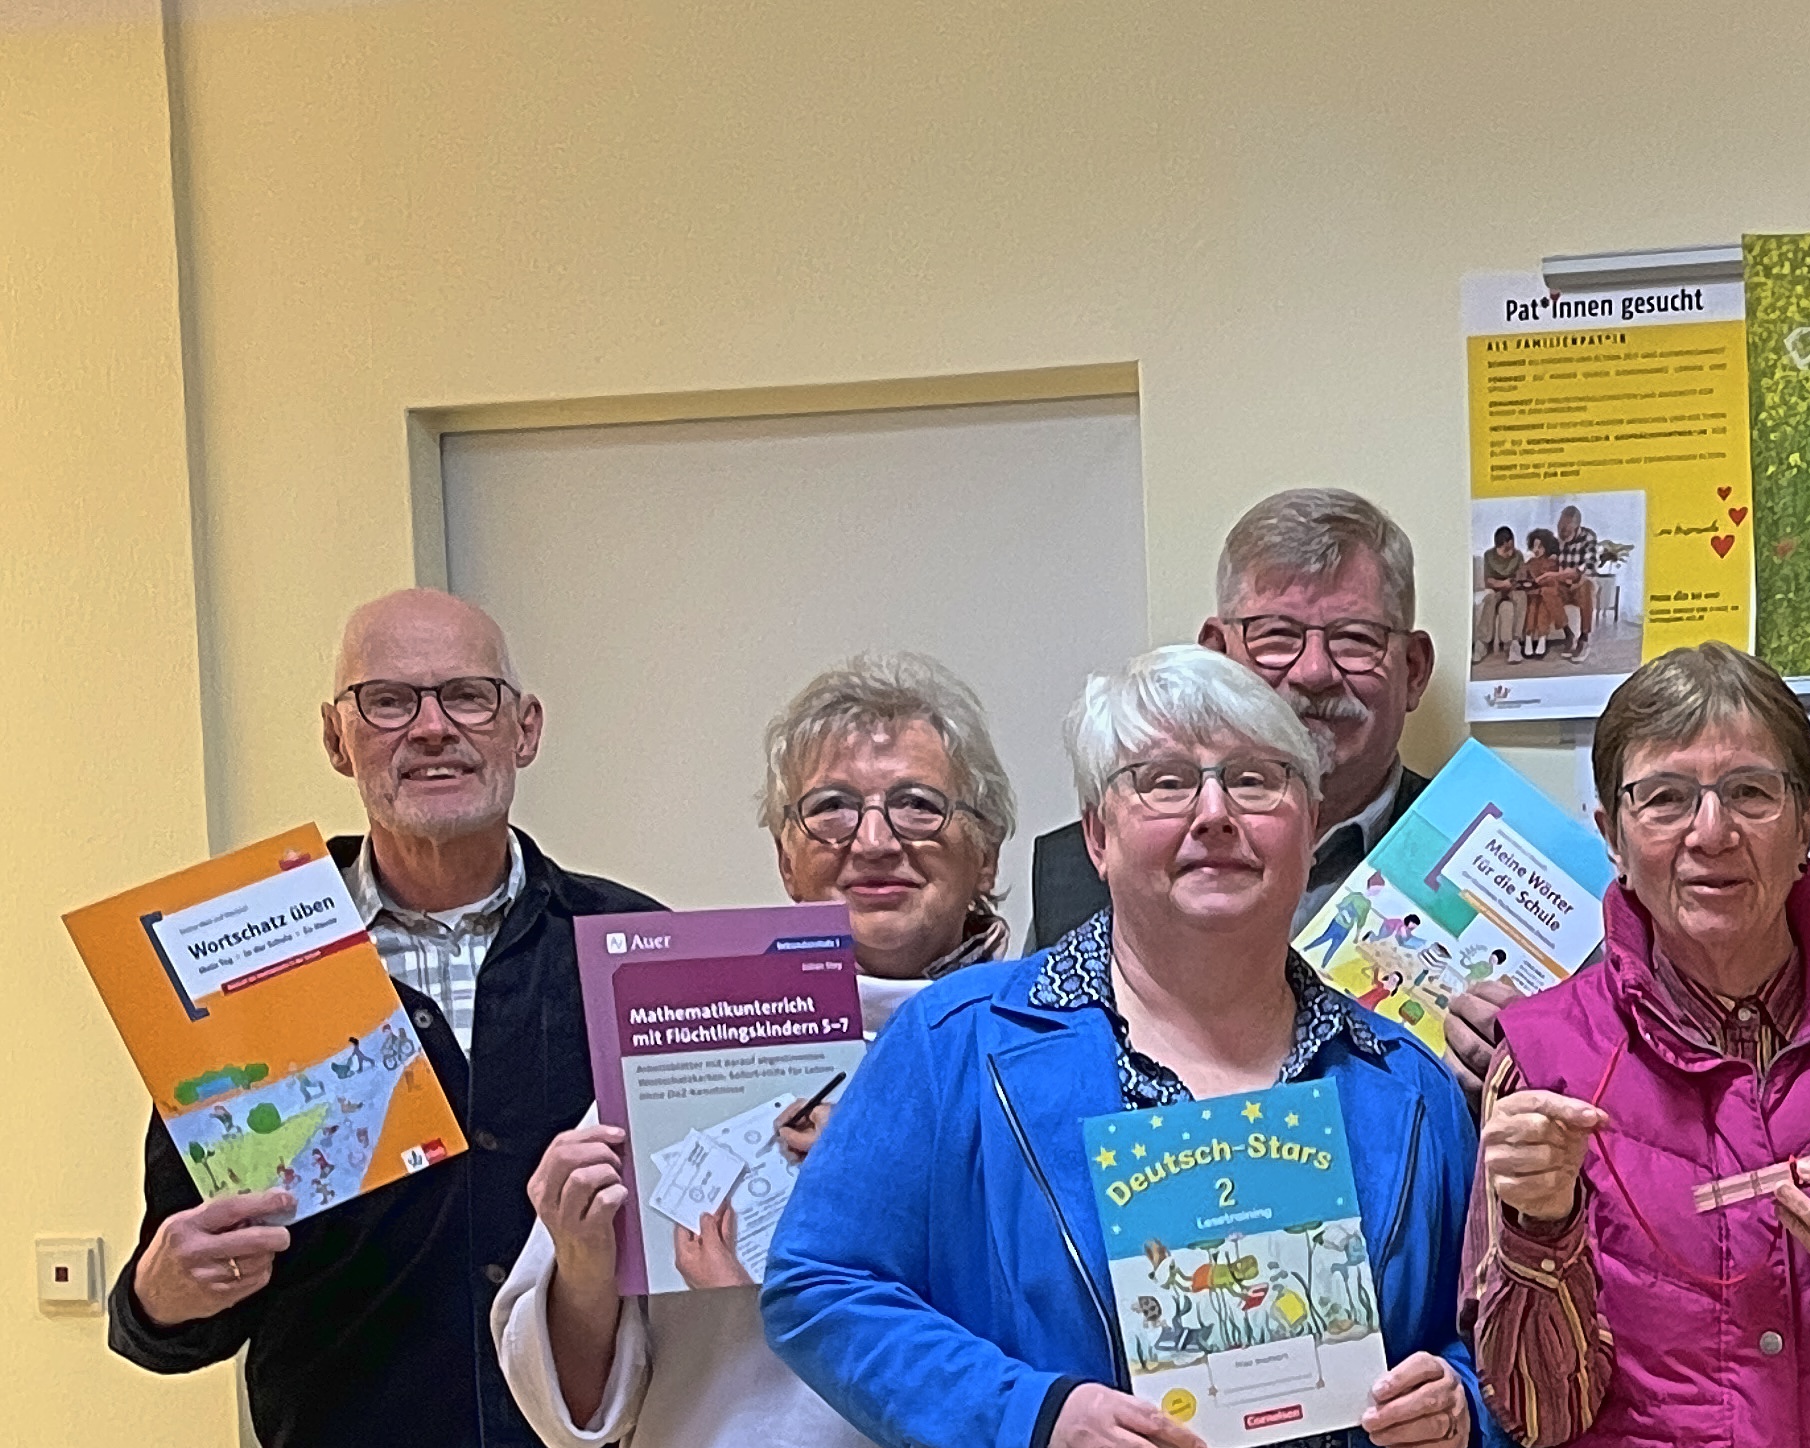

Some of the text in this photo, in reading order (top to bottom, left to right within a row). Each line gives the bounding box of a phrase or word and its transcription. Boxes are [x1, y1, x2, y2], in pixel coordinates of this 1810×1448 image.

[1621, 288, 1705, 320] gesucht
[1485, 838, 1527, 878] Meine
[1528, 870, 1574, 914] Wörter
[1472, 854, 1560, 931] für die Schule
[187, 913, 288, 960] Wortschatz
[290, 896, 336, 922] üben
[630, 934, 671, 951] Auer
[630, 996, 816, 1025] Mathematikunterricht
[633, 1028, 662, 1047] mit
[666, 1018, 819, 1045] Flüchtlingskindern
[1106, 1132, 1333, 1208] Deutsch-Stars
[1214, 1177, 1237, 1208] 2
